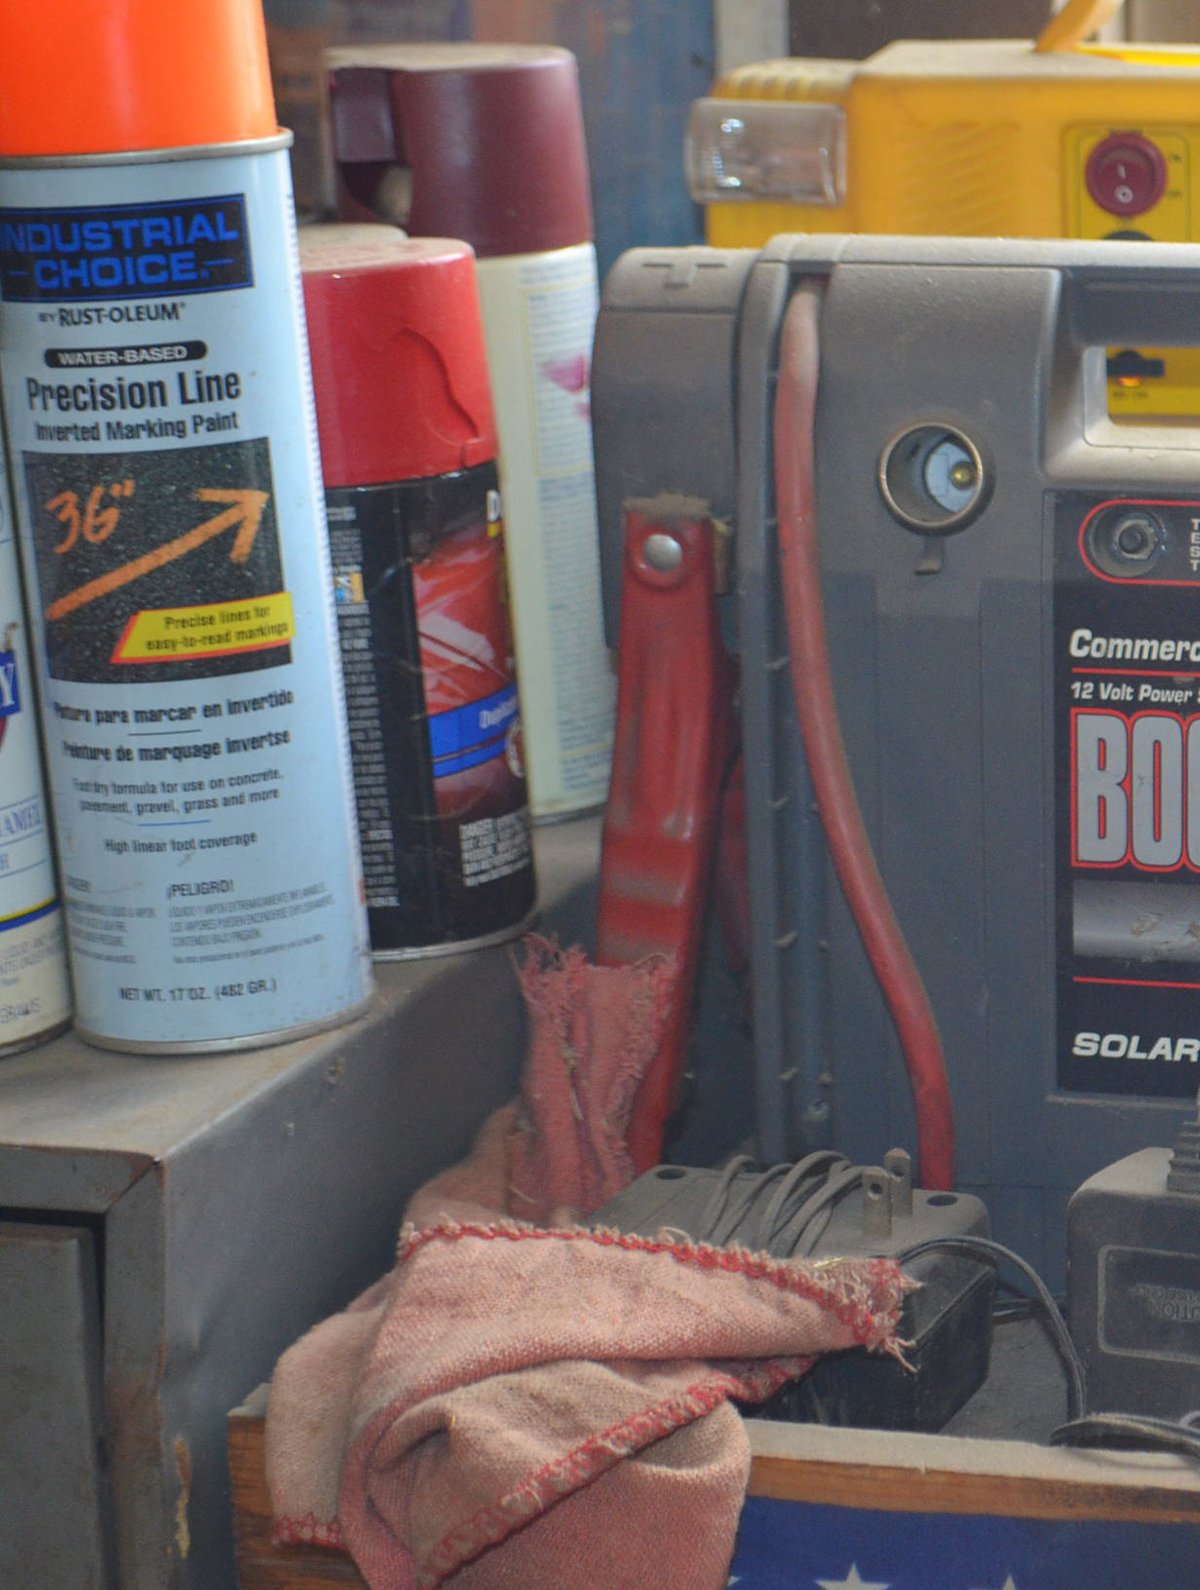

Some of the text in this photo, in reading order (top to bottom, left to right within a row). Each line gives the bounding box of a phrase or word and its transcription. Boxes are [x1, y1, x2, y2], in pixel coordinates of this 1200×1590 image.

[57, 346, 188, 366] WATER-BASED
[26, 370, 242, 412] Precision Line
[36, 411, 239, 441] Inverted Marking Paint
[164, 605, 270, 631] Precise lines for
[145, 622, 288, 652] easy-to-read markings
[1071, 682, 1094, 700] 12
[1099, 682, 1134, 702] Volt
[1138, 683, 1193, 704] Power
[95, 709, 129, 725] para
[134, 706, 197, 724] marcar
[203, 703, 222, 717] en
[227, 689, 294, 715] invertido
[116, 746, 133, 761] de
[139, 742, 222, 763] marquage
[111, 781, 157, 794] formula
[160, 780, 178, 793] for
[183, 777, 205, 791] use
[210, 776, 225, 789] on
[183, 799, 218, 814] grass
[222, 796, 246, 809] and
[249, 788, 279, 803] more
[104, 838, 129, 853] High
[133, 841, 167, 852] linear
[200, 831, 257, 851] coverage
[1072, 1032, 1200, 1063] SOLAR
